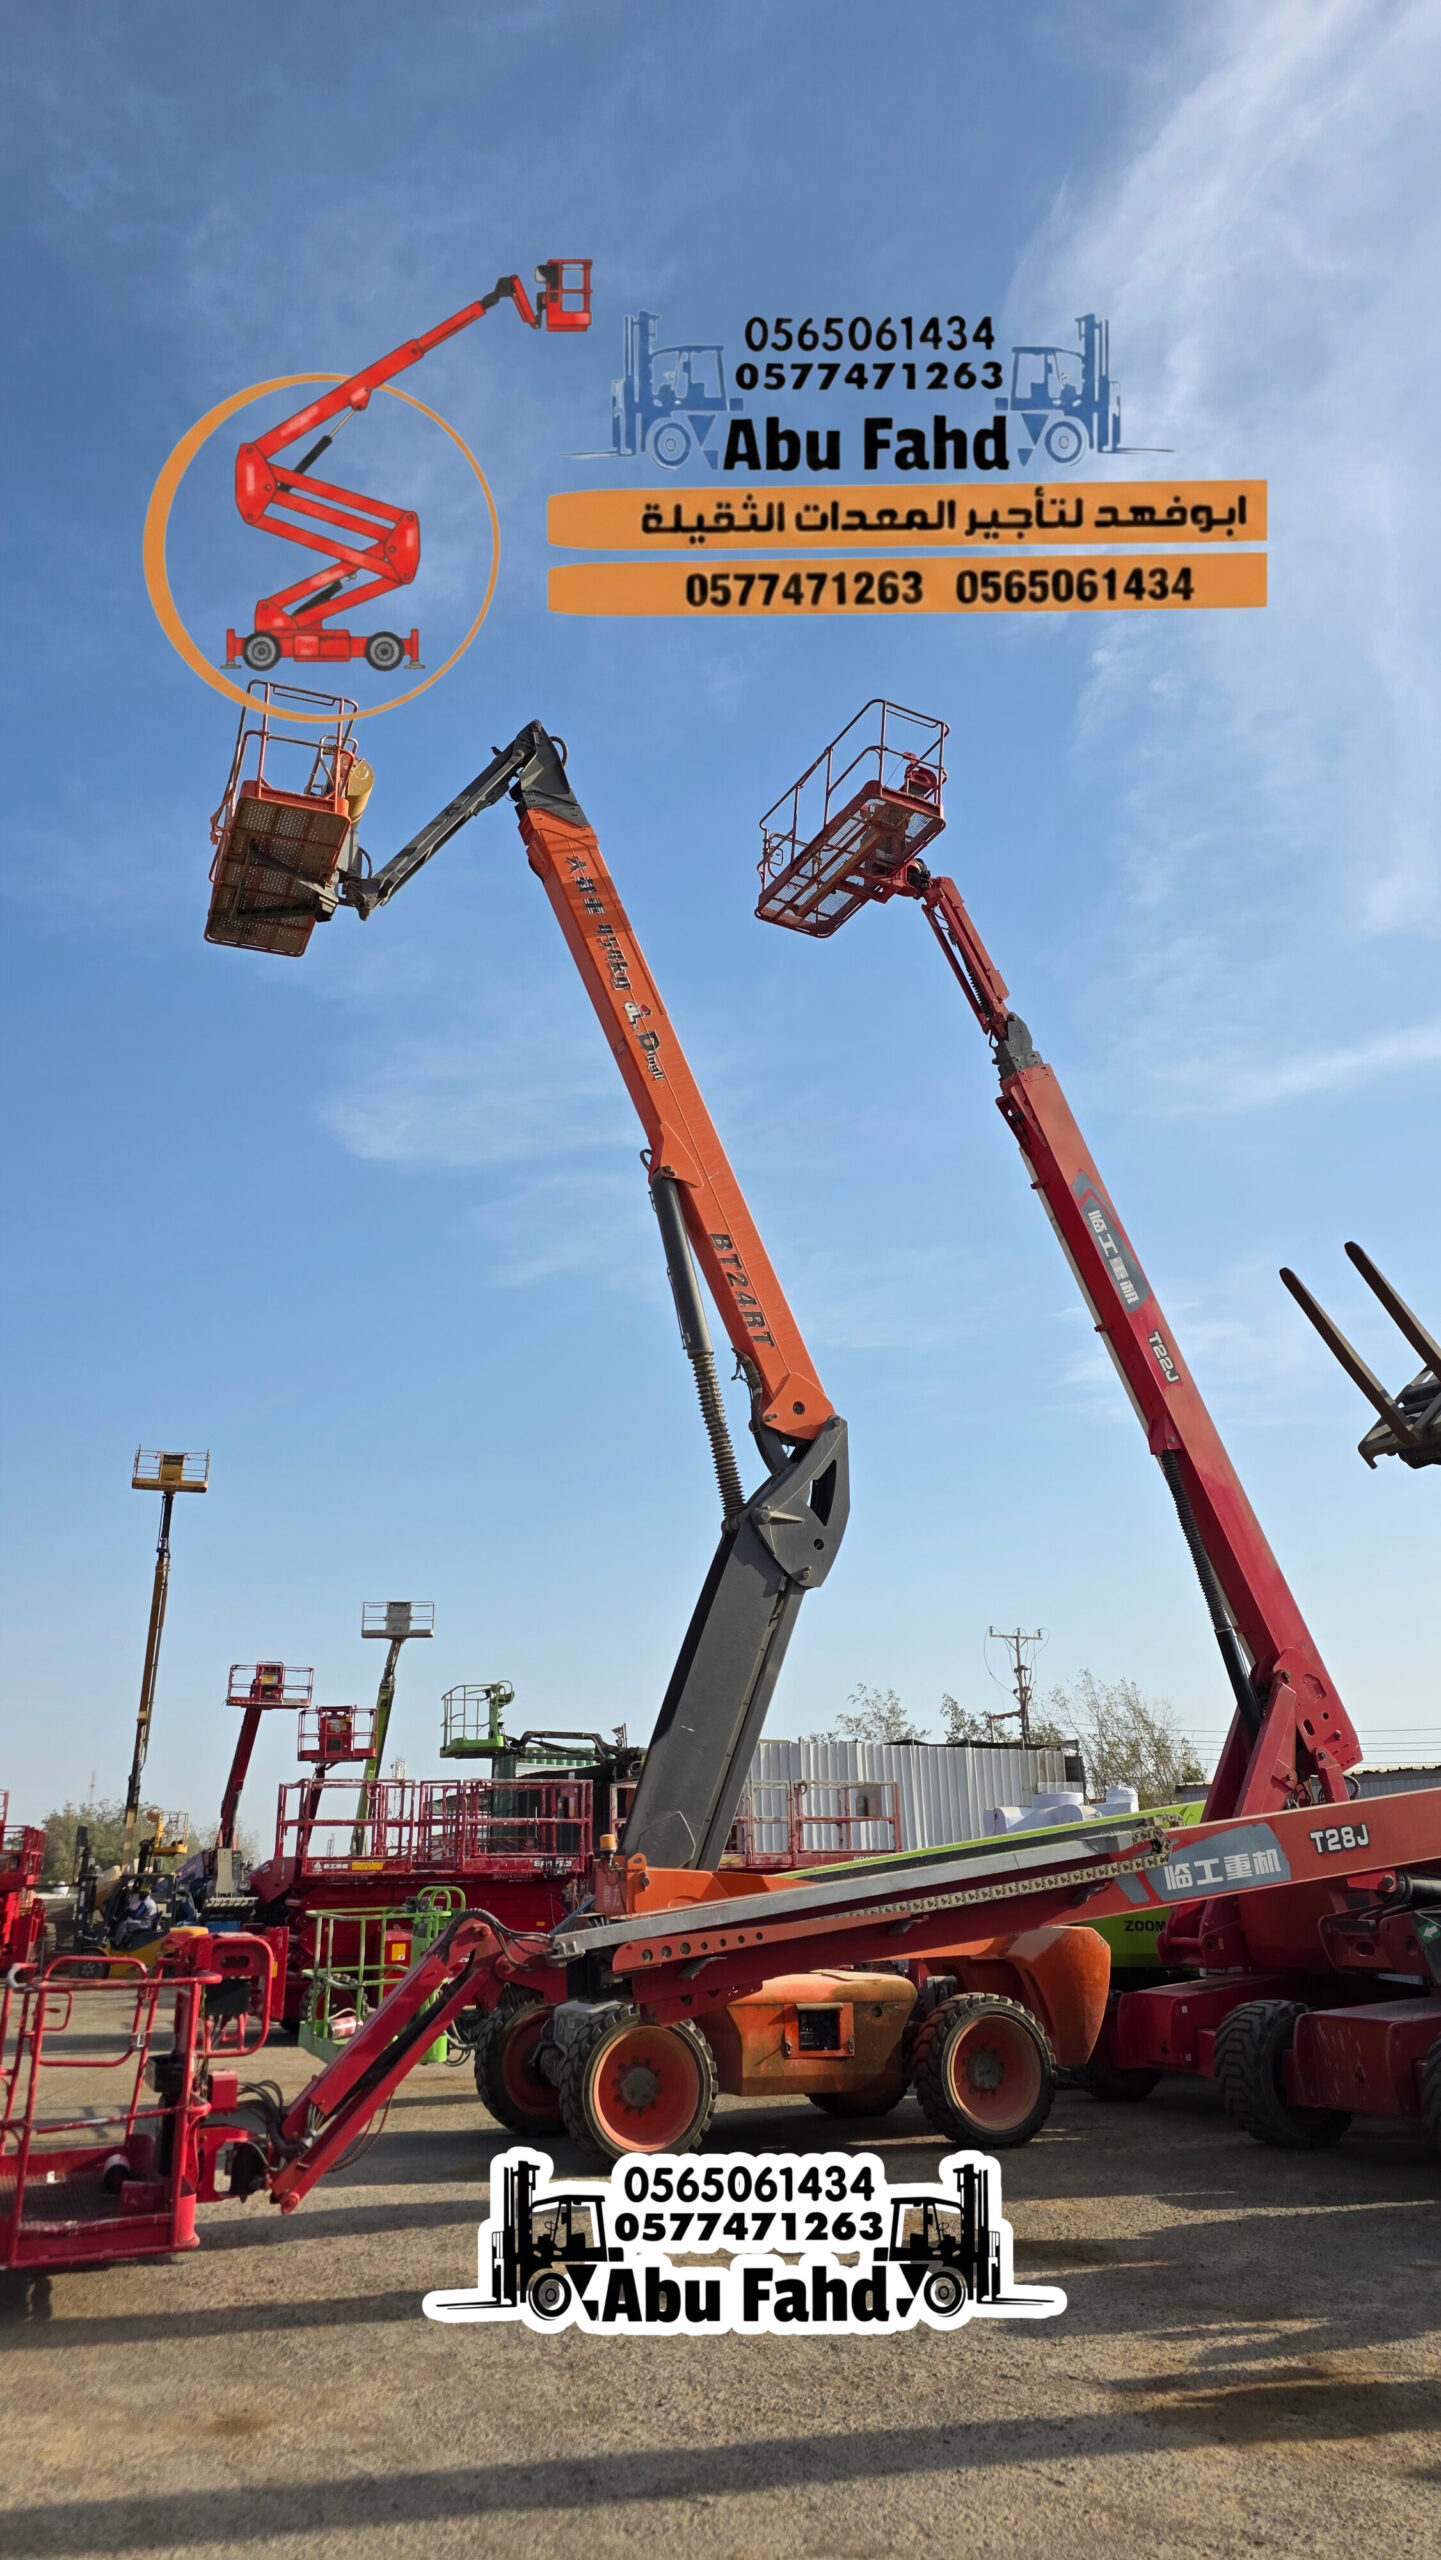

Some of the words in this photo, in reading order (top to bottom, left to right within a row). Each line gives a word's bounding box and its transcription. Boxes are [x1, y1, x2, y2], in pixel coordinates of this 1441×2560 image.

[636, 1029, 666, 1081] Dingli
[1087, 1209, 1140, 1305] 临工重机
[710, 1233, 776, 1348] BT24RT
[1147, 1329, 1181, 1384] T22J
[1309, 1823, 1371, 1855] T28J
[1163, 1848, 1283, 1891] 临工重机
